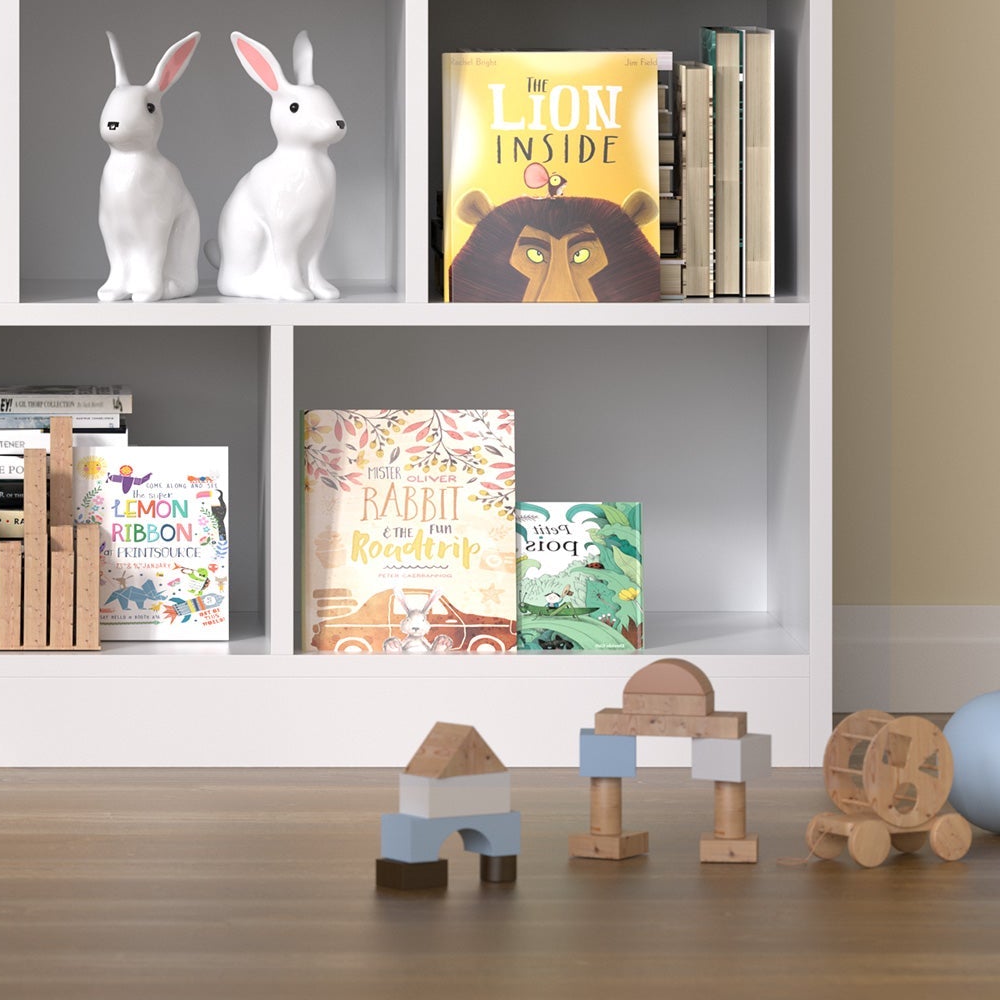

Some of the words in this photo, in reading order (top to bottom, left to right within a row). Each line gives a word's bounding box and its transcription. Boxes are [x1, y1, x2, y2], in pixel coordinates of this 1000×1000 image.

[476, 58, 497, 67] Bright
[625, 58, 637, 66] Jim
[640, 58, 658, 66] Field
[527, 77, 549, 93] THE
[488, 83, 623, 131] LION
[497, 133, 618, 164] INSIDE
[368, 467, 401, 480] MISTER
[133, 490, 147, 498] the
[360, 482, 463, 522] RABBIT
[111, 499, 188, 518] LEMON
[111, 523, 192, 543] RIBBON
[393, 527, 413, 538] THE
[117, 547, 201, 558] PRINTSOURCE
[351, 529, 480, 569] Roadtrip
